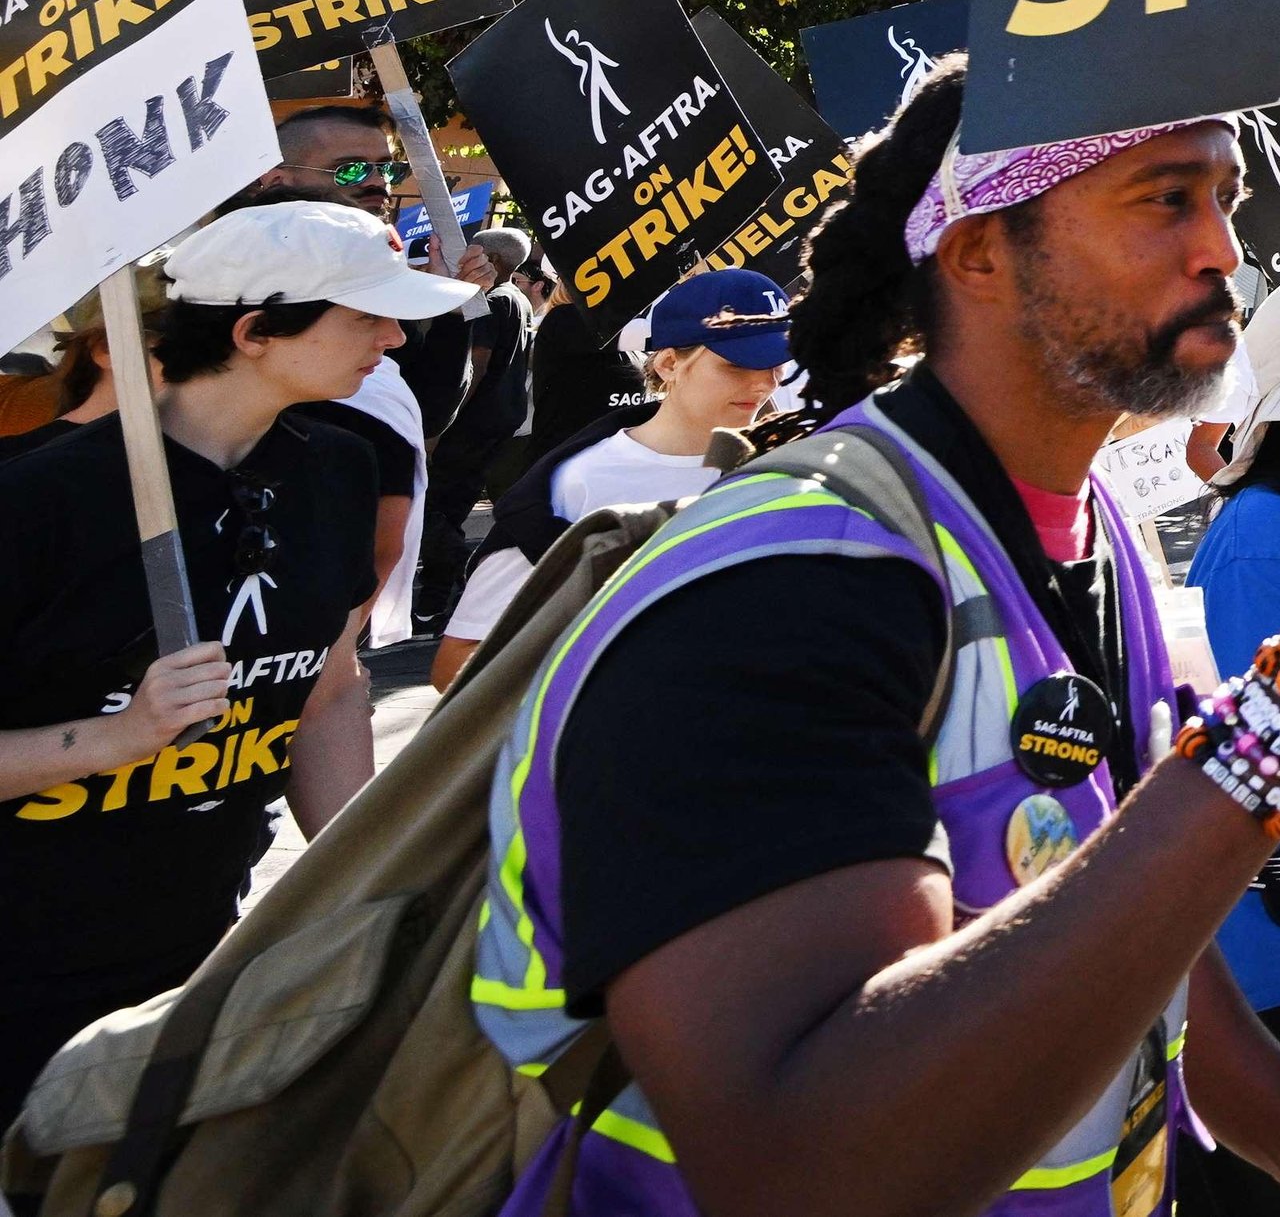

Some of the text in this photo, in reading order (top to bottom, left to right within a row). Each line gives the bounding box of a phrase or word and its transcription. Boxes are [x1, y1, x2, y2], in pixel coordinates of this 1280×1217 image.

[573, 124, 757, 309] STRIKE!
[634, 163, 674, 206] ON
[706, 153, 854, 271] UELGA!
[15, 719, 301, 821] STRIK
[1019, 733, 1100, 766] STRONG
